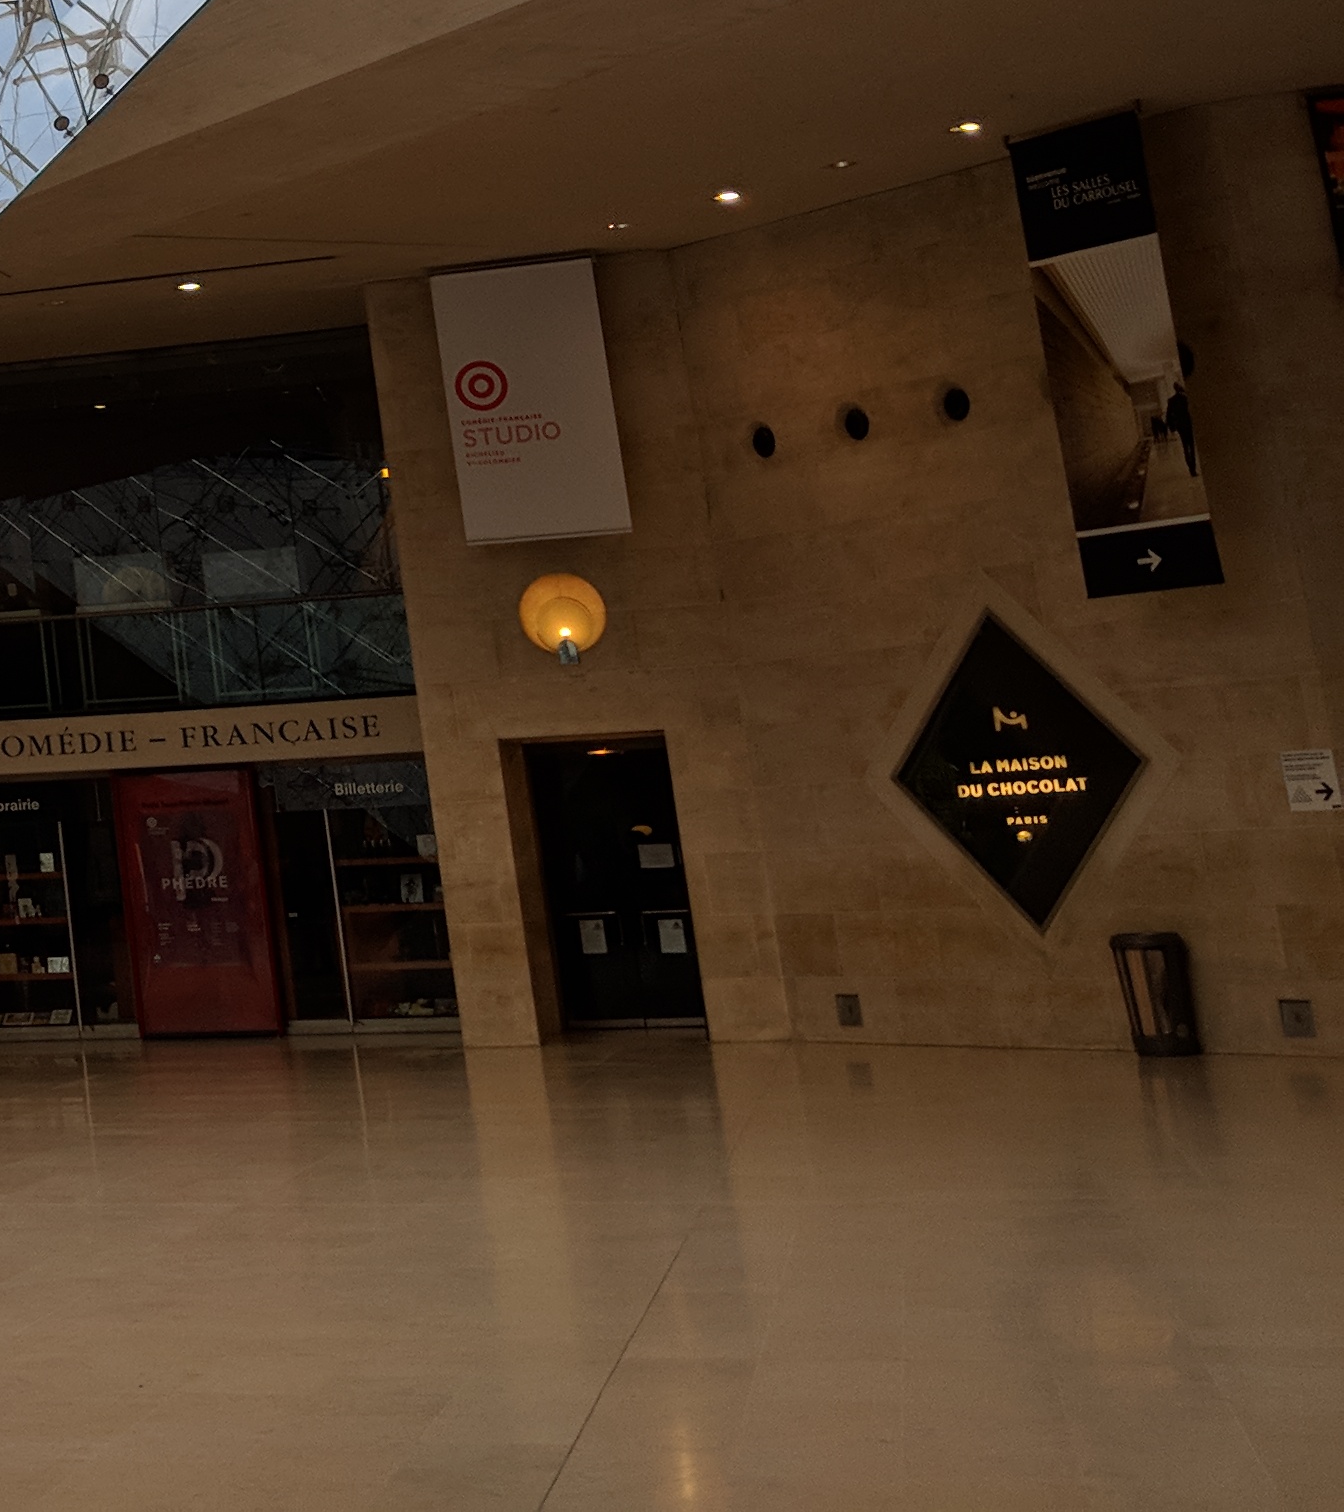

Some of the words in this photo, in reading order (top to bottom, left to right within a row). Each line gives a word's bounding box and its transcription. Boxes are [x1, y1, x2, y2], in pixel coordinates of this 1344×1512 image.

[1051, 184, 1070, 199] LES
[1072, 173, 1111, 193] SALLES
[1053, 197, 1070, 210] DU
[1073, 179, 1139, 206] CARROUSEL
[462, 420, 561, 448] STUDIO
[179, 713, 381, 749] FRANÇAISE
[968, 759, 994, 775] LA
[995, 754, 1069, 774] MAISON
[334, 779, 405, 797] Billetterie
[956, 782, 984, 799] DU
[986, 776, 1089, 798] CHOCOLAT
[1005, 814, 1049, 826] PARIS
